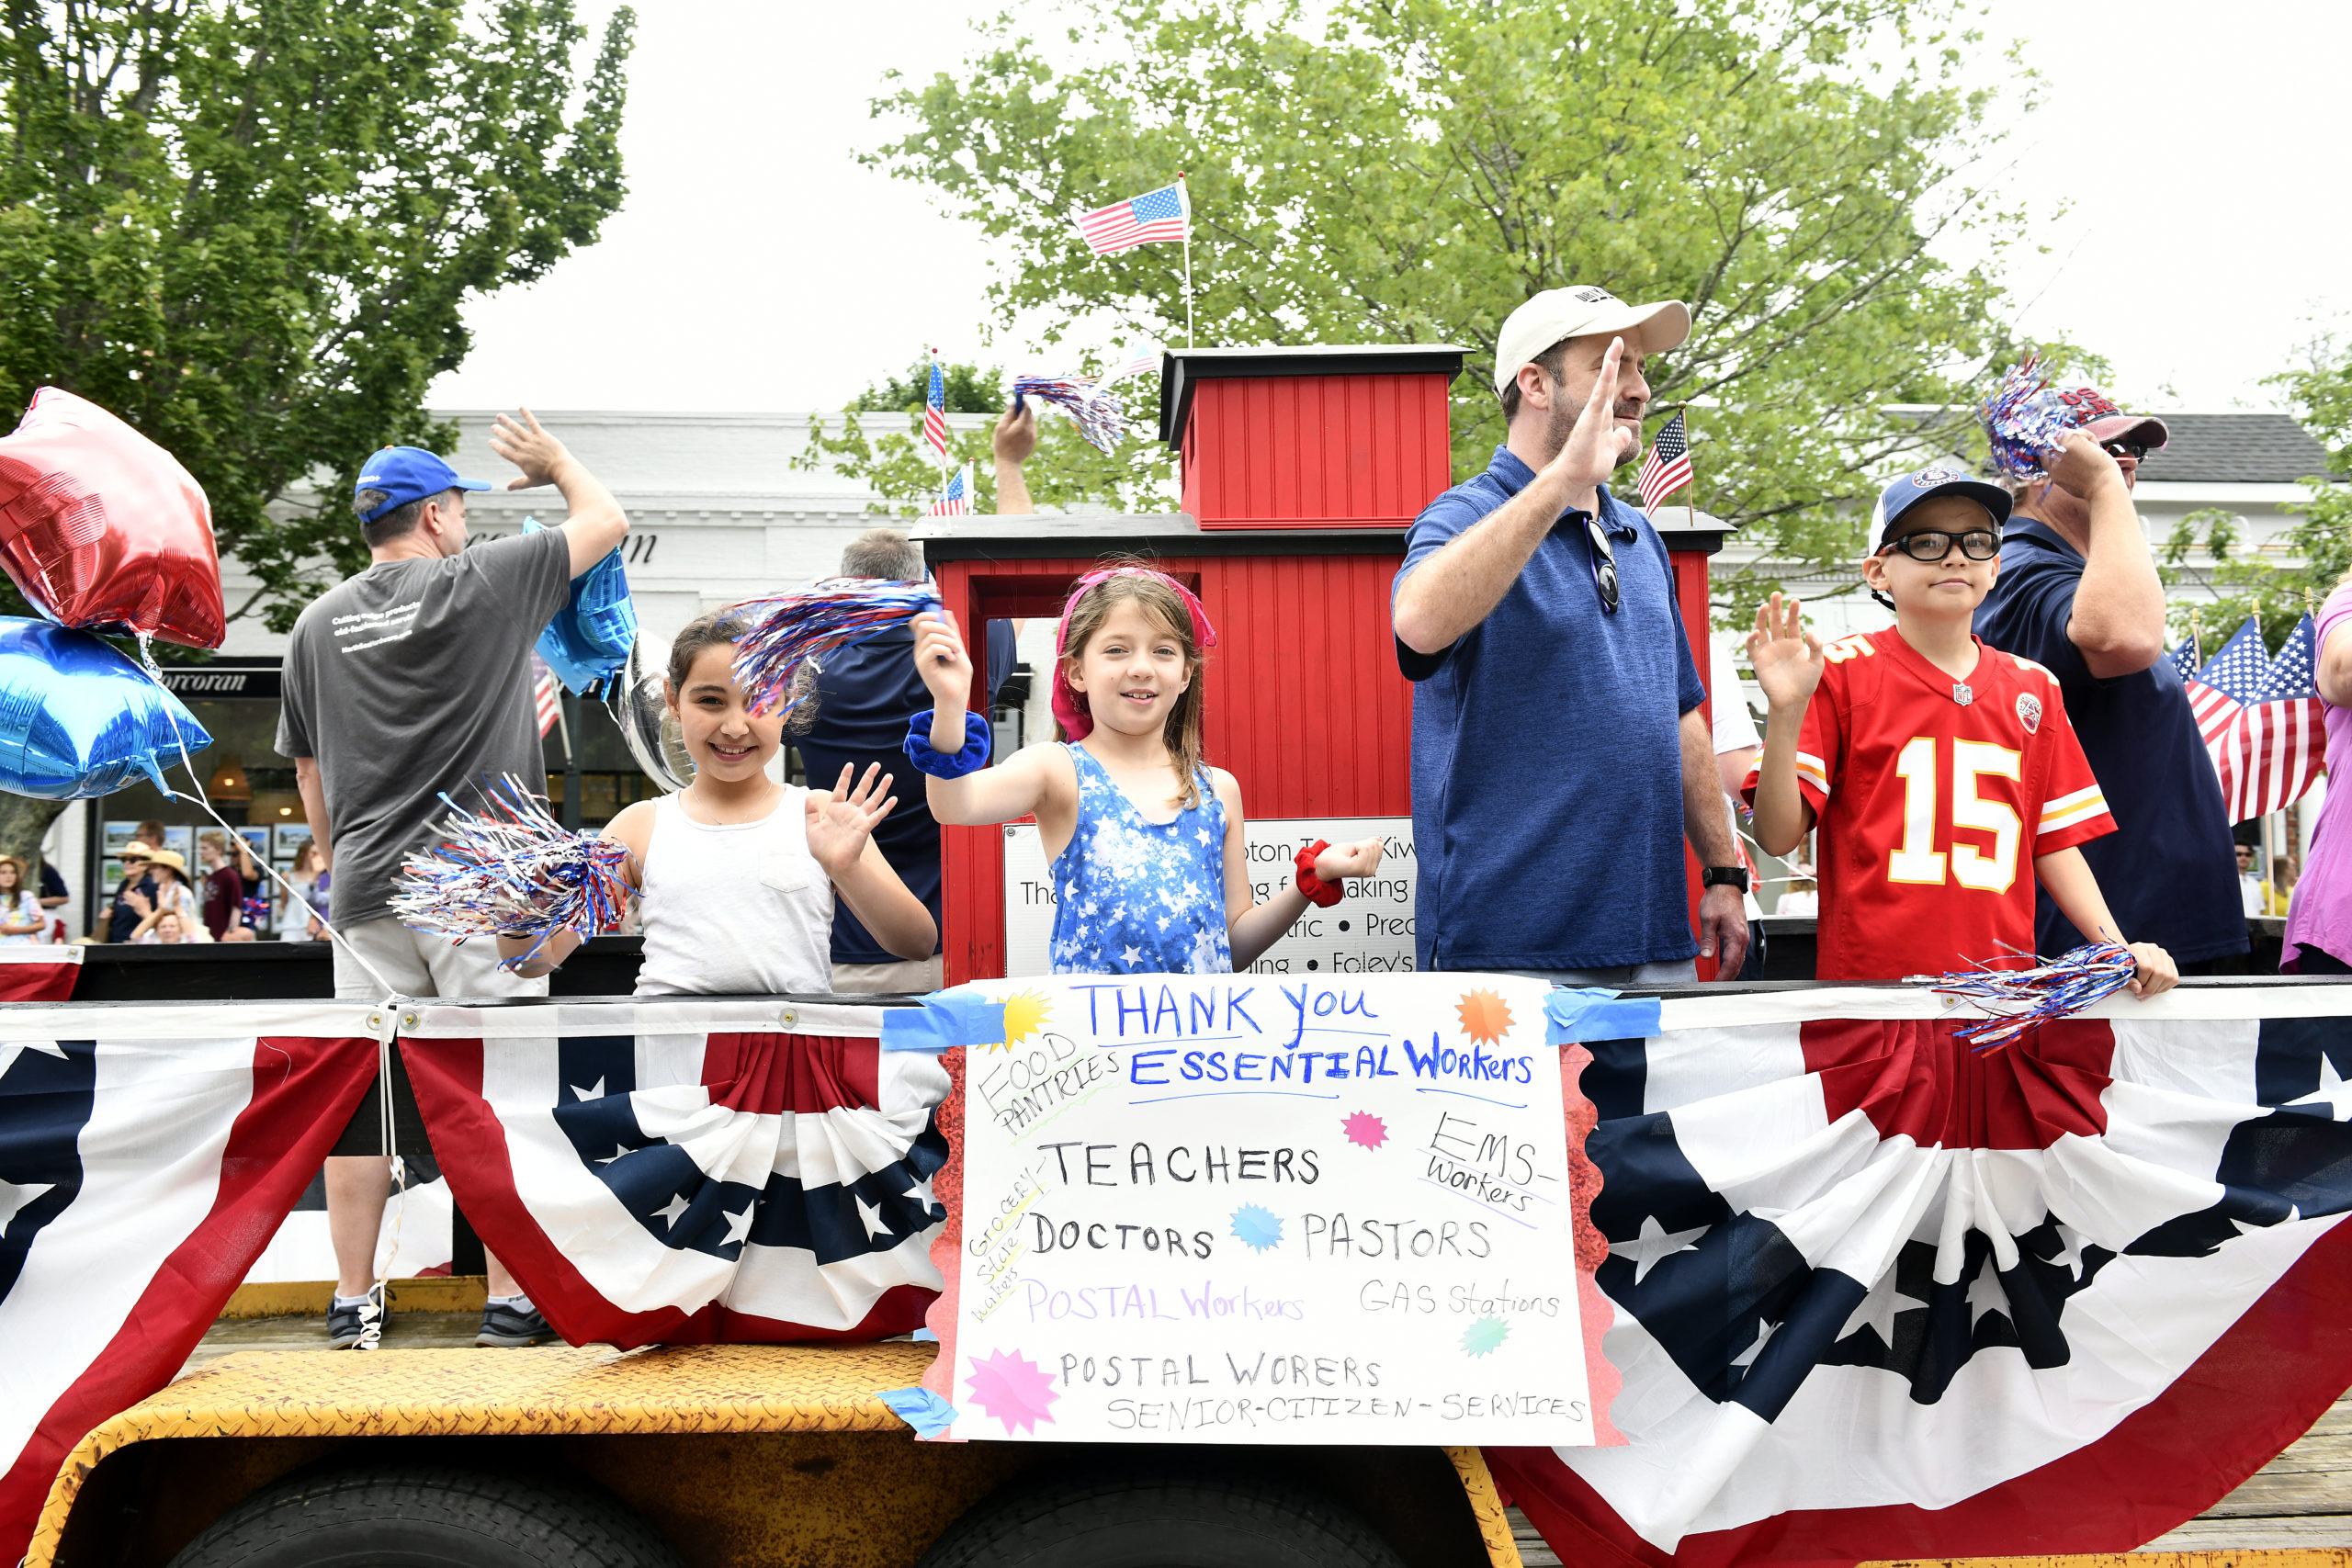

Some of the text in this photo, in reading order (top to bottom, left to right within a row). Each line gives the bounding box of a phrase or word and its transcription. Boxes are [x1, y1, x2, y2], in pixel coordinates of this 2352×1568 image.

[332, 614, 361, 626] Cutting
[385, 602, 421, 619] products
[161, 673, 247, 692] orcoran
[1957, 692, 1971, 703] NFL
[1887, 735, 2023, 896] 15
[1341, 874, 1409, 904] aking
[1069, 984, 1263, 1037] THANK
[978, 1032, 1076, 1116] FOOD
[1130, 1045, 1399, 1086] ESSENTIAL
[993, 1051, 1120, 1136] PANTRIES
[1037, 1141, 1320, 1186] TEACHERS
[1028, 1212, 1215, 1260] DOCTORS
[1300, 1213, 1491, 1261] PASTORS
[1019, 1278, 1182, 1324] POSTAL
[1360, 1279, 1437, 1314] GAS
[1060, 1350, 1382, 1388] POSTAL WORERS
